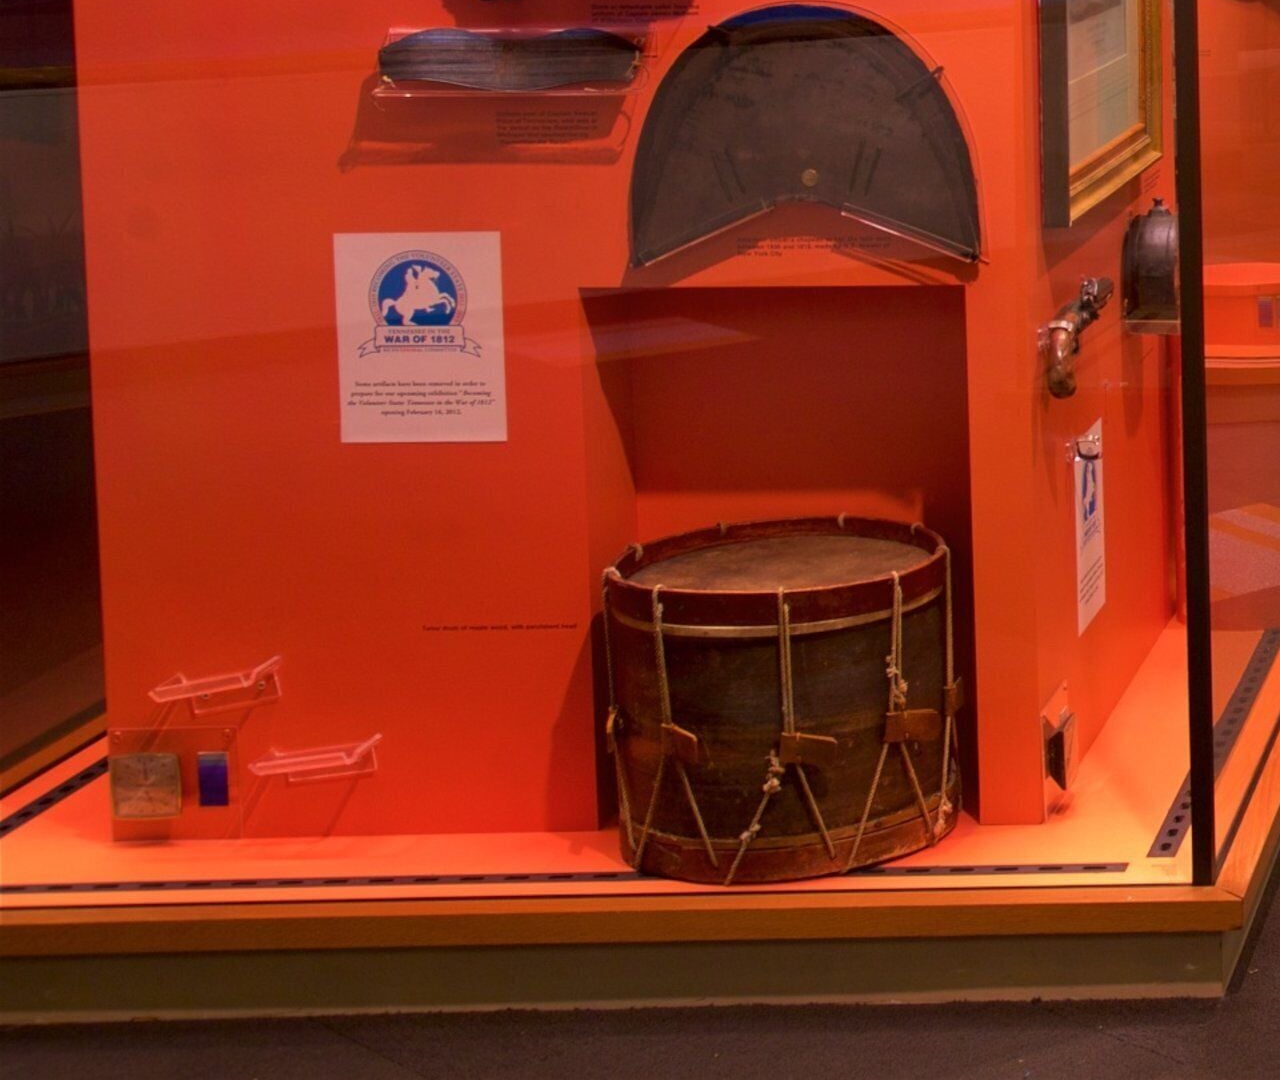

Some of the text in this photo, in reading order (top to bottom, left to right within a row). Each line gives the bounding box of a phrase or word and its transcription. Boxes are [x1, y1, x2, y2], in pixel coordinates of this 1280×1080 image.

[384, 335, 455, 343] WAR OF 1812
